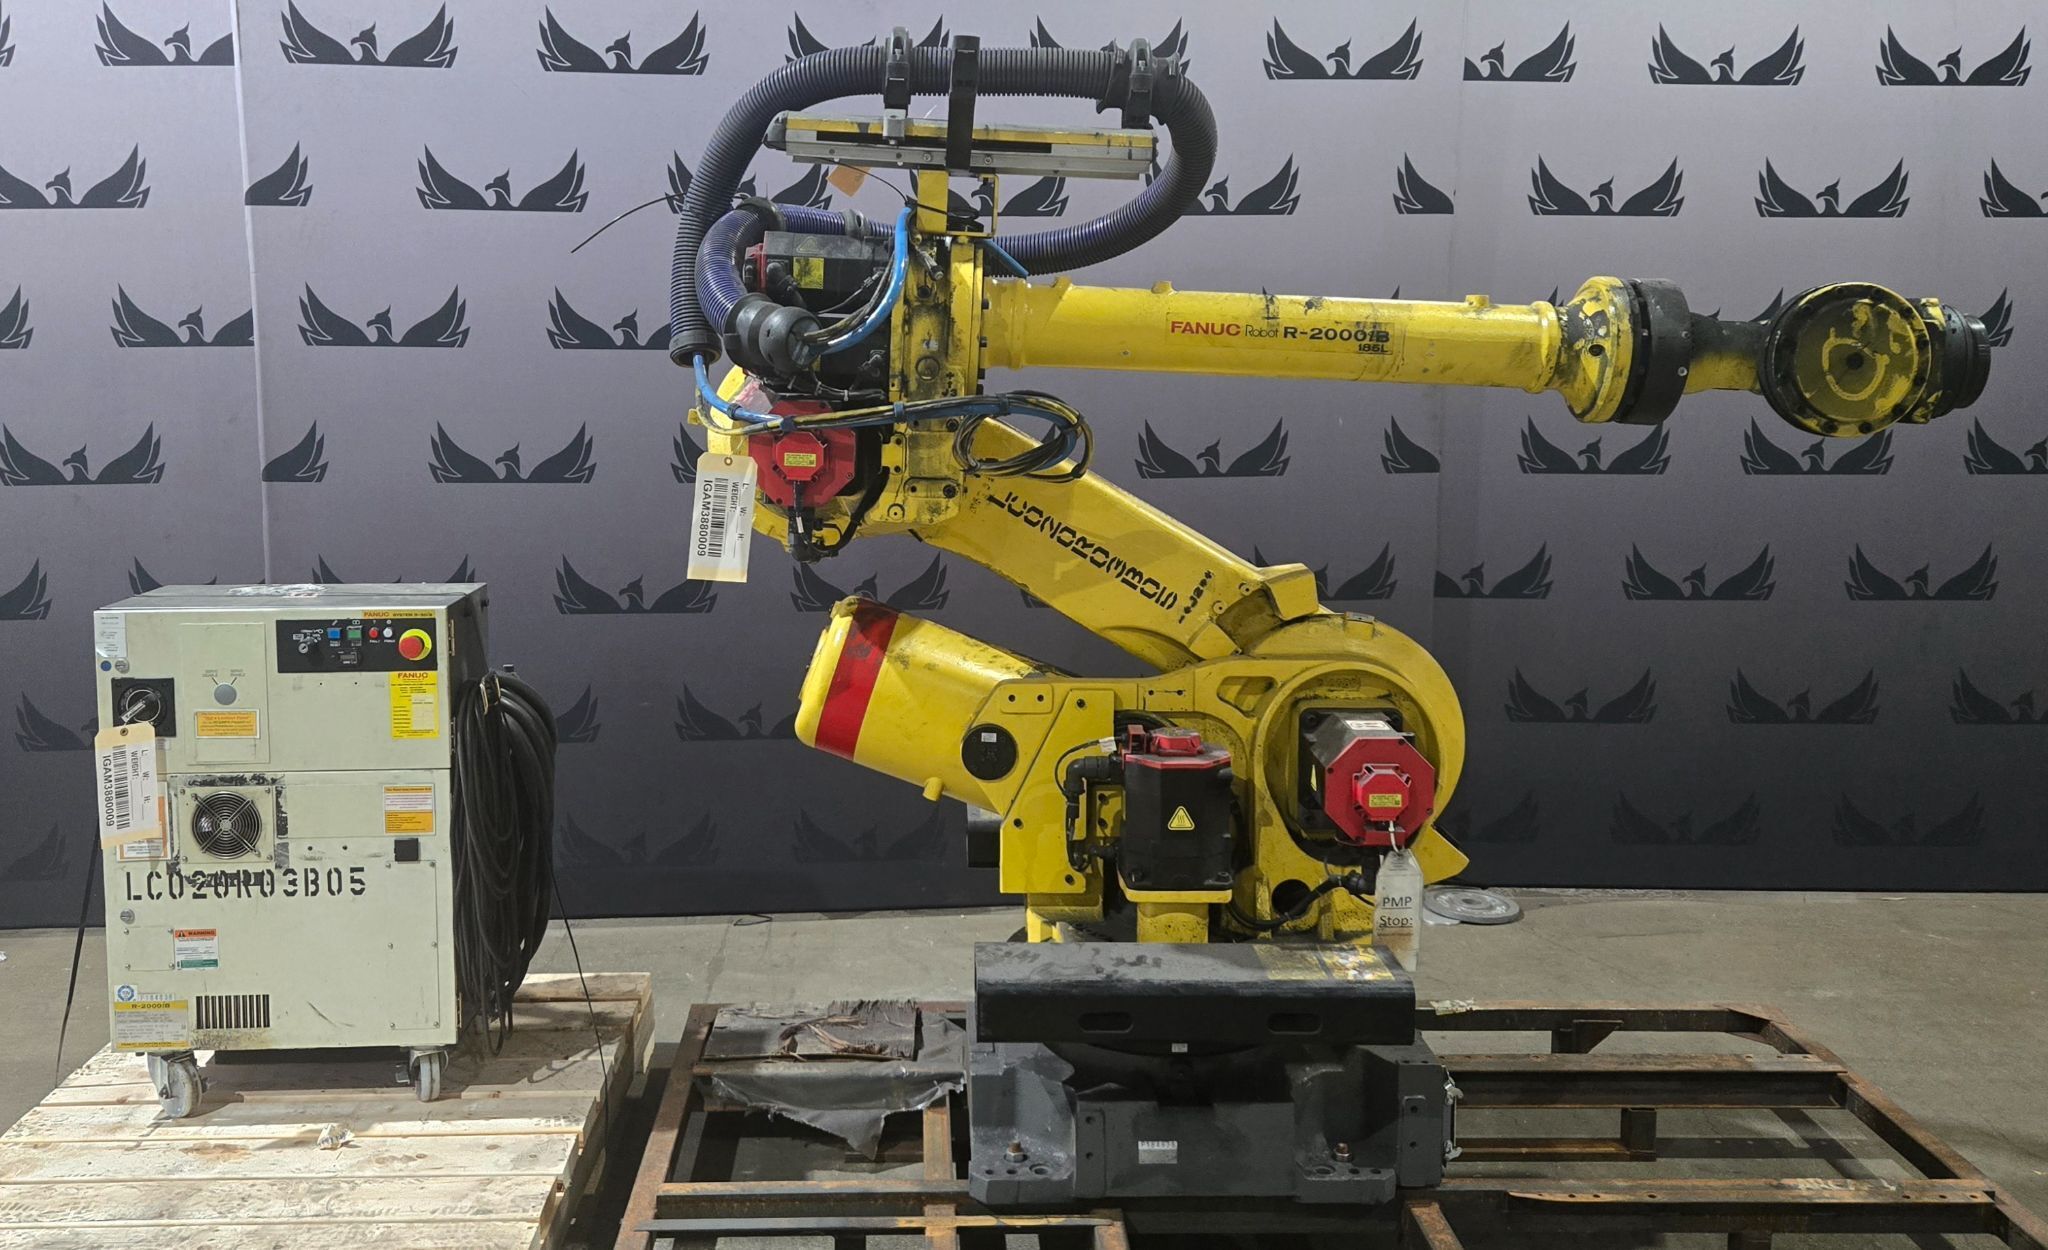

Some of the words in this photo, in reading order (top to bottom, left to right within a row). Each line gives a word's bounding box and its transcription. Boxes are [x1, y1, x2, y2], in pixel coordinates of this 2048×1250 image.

[1171, 321, 1241, 336] FANUC
[1245, 324, 1280, 338] Robot
[729, 482, 740, 512] WEIGHT:
[697, 480, 713, 557] IGAM3880009
[131, 751, 139, 779] WEIGHT:
[102, 755, 115, 827] IGAM3880009
[1382, 896, 1413, 907] PMP
[1379, 915, 1413, 929] Stop:
